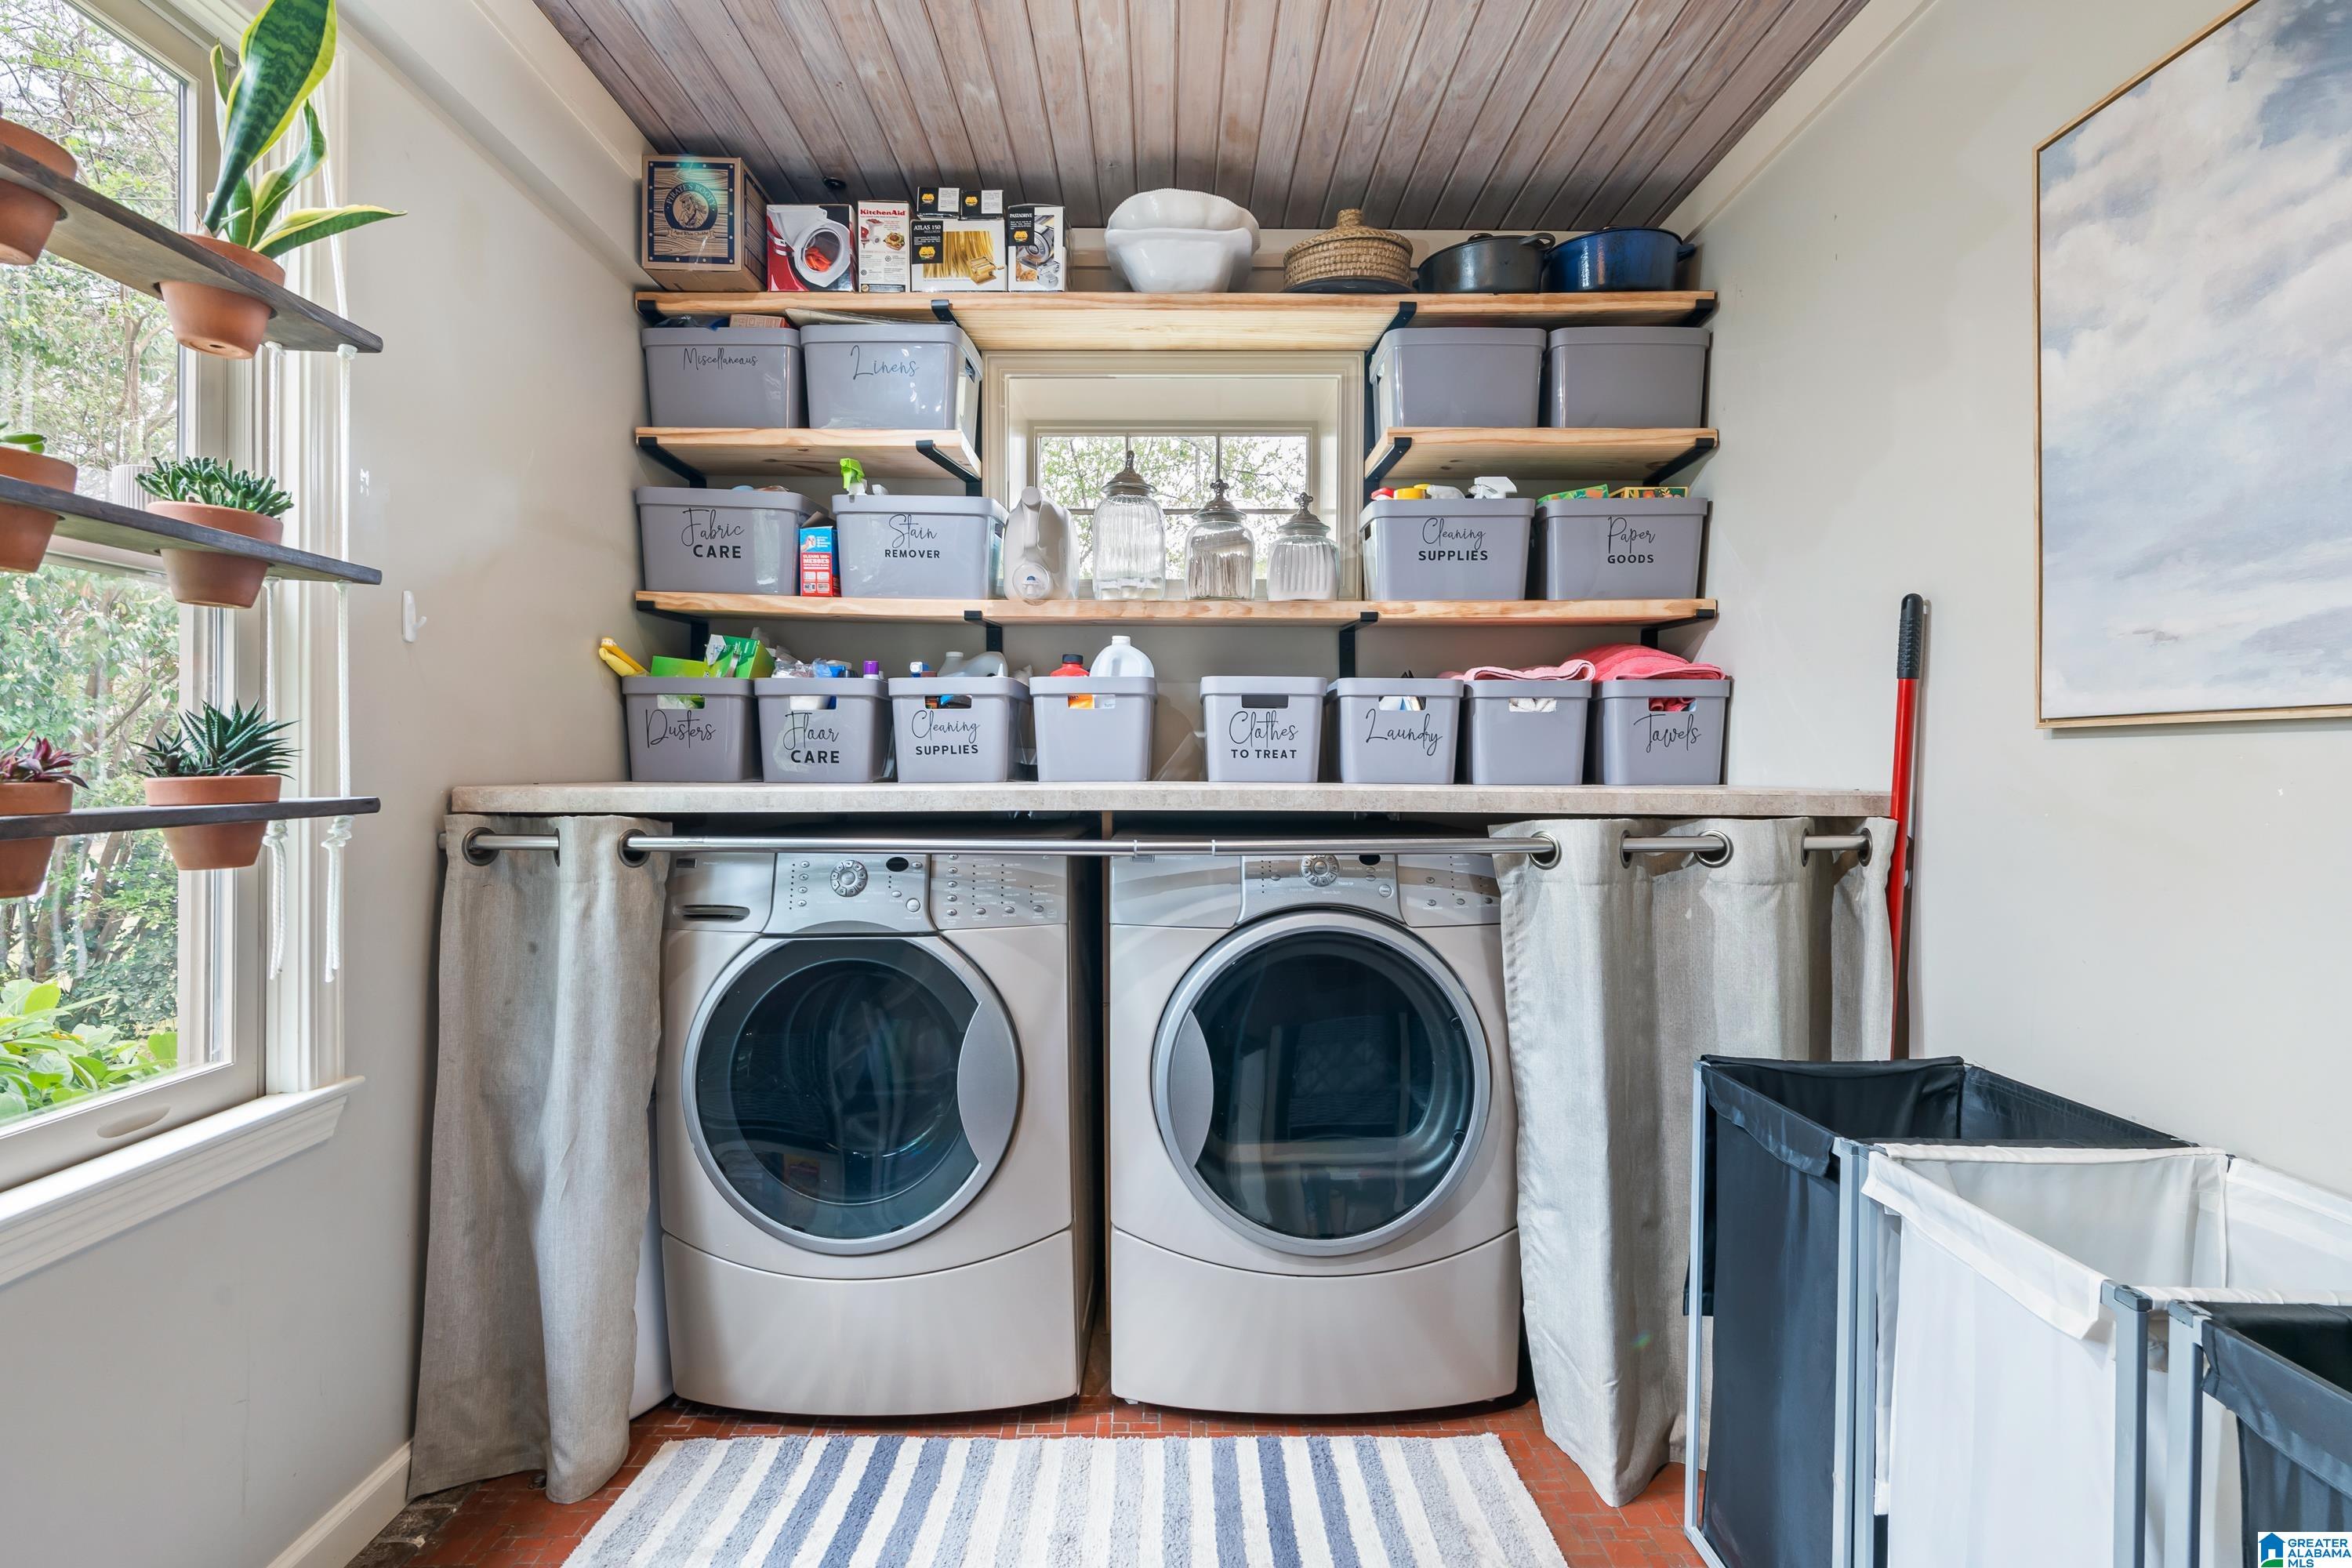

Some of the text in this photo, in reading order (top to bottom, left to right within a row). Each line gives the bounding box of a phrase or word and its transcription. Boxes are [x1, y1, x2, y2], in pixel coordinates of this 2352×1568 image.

[695, 183, 717, 205] BOOTY
[683, 347, 758, 370] Miscellaneous
[850, 344, 920, 380] Linens
[681, 508, 745, 546] Fabric
[889, 514, 938, 550] Stain
[1422, 517, 1486, 550] Cleaning
[1607, 516, 1655, 554] Paper
[693, 544, 742, 559] CARE
[885, 549, 941, 559] REMOVER
[1418, 550, 1488, 561] SUPPLIES
[1607, 554, 1654, 564] GOODS
[645, 709, 717, 748] Dusters
[911, 710, 981, 743] Cleaning
[1229, 710, 1299, 749] Clothes
[1366, 709, 1443, 757] Laundry
[1634, 713, 1702, 753] Towels
[790, 750, 840, 764] CARE
[916, 745, 979, 756] SUPPLIES
[1231, 750, 1297, 759] TO TREAT
